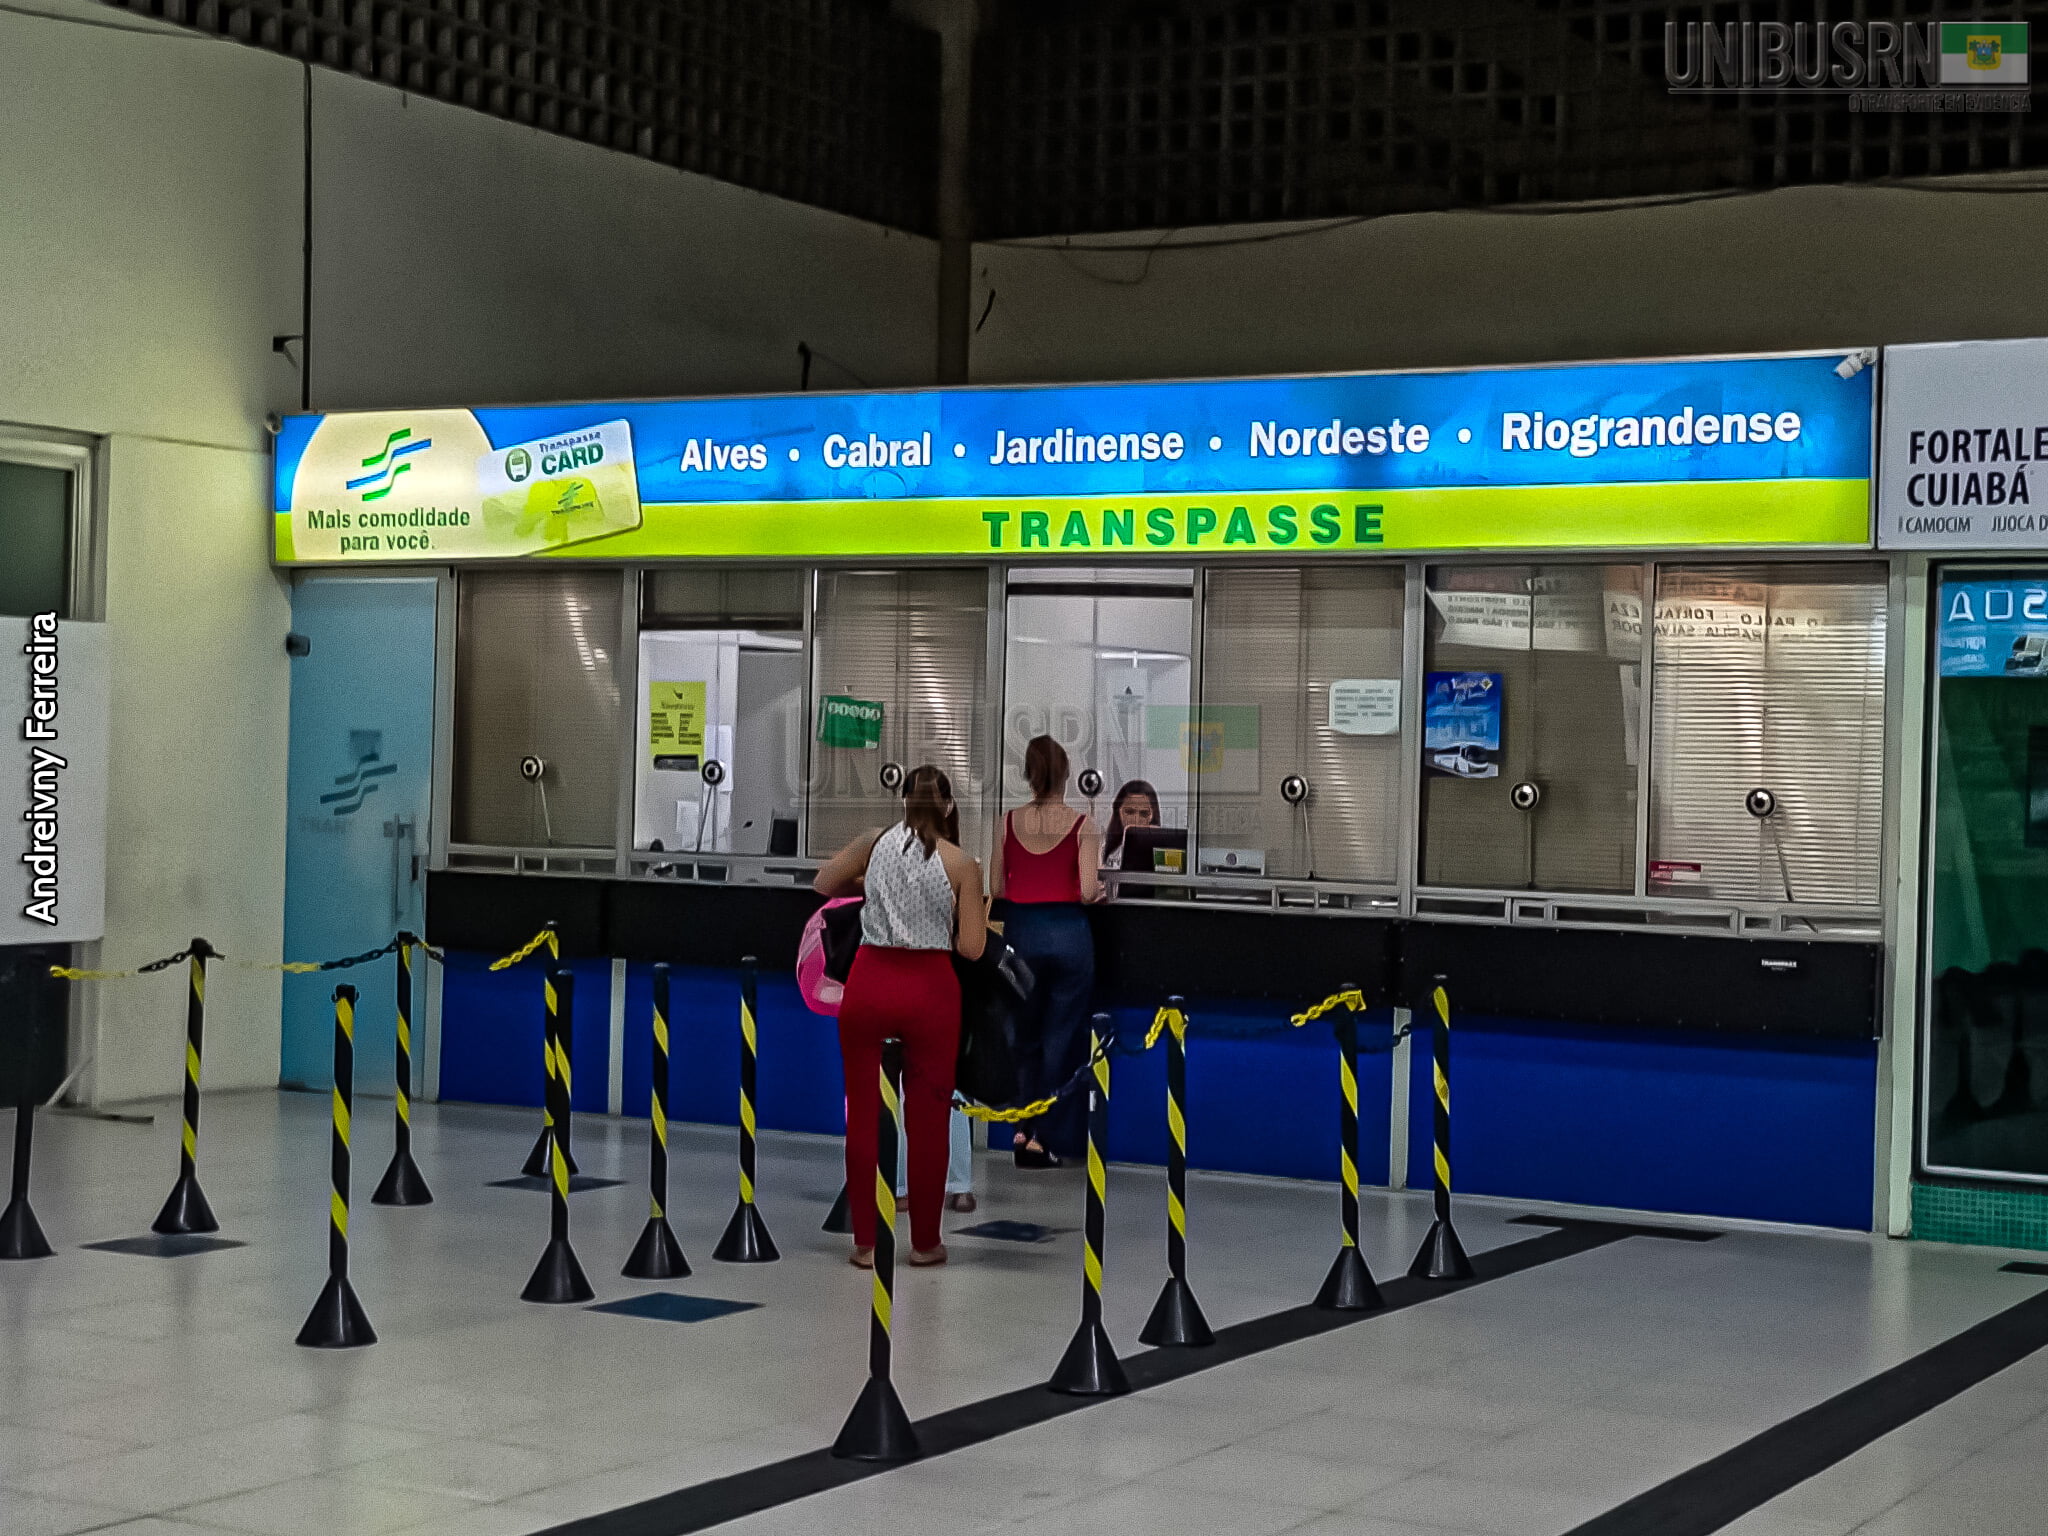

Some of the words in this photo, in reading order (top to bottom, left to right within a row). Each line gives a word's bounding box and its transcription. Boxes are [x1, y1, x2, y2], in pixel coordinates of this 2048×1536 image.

[680, 438, 768, 472] Alves
[823, 431, 932, 469] Cabral
[989, 426, 1185, 466] Jardinense
[1249, 417, 1430, 458] Nordeste
[1501, 406, 1801, 458] Riograndense
[541, 443, 604, 475] CARD
[1907, 464, 2030, 507] CUIABÁ
[307, 509, 351, 529] Mais
[358, 507, 471, 528] comodidade
[981, 504, 1385, 549] TRANSPASSE
[1905, 516, 1971, 533] CAMOCIM
[1991, 513, 2035, 532] JIJOCA
[340, 535, 380, 554] para
